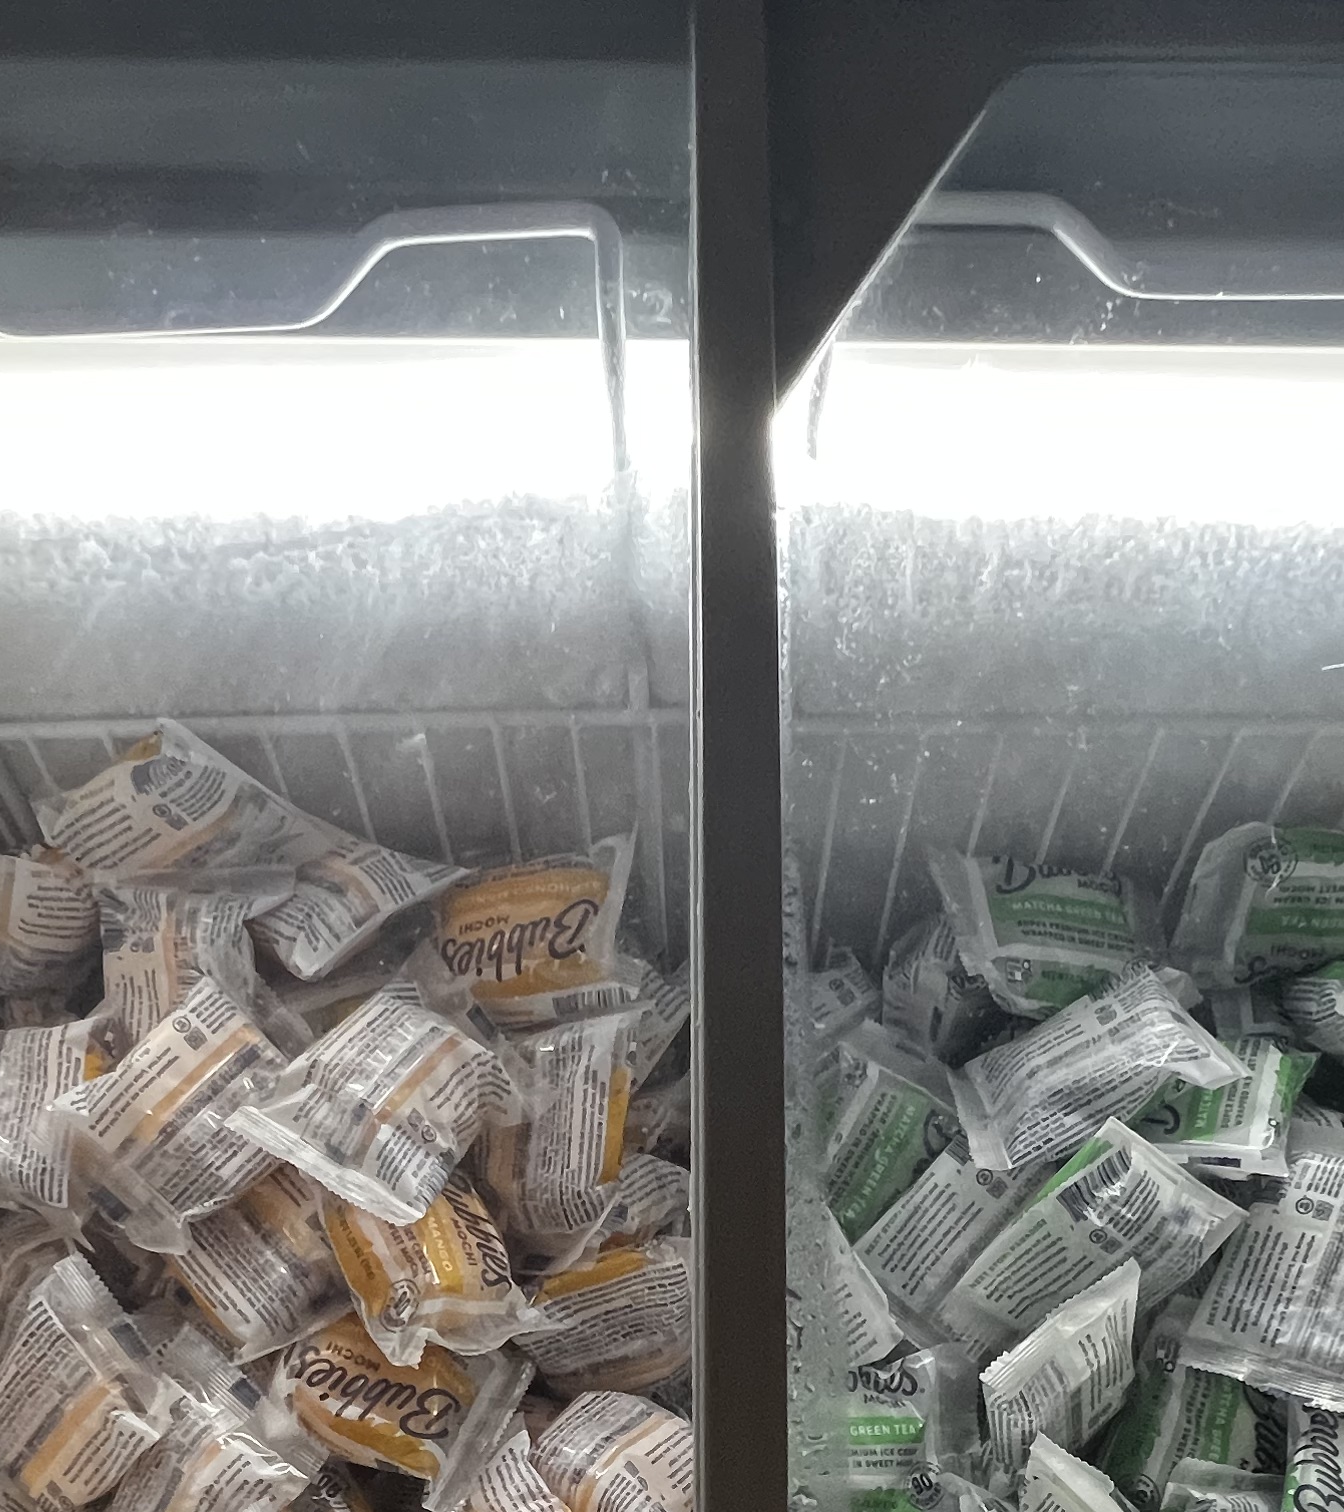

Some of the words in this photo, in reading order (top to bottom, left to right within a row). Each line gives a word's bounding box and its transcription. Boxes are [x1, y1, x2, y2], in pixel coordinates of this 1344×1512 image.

[459, 915, 511, 936] MOCHI
[1012, 900, 1062, 912] MATCHA
[441, 899, 599, 982] Bubbies
[427, 1216, 453, 1272] MANGO
[450, 1217, 477, 1266] MOCHI
[327, 1341, 380, 1372] MOCHI
[286, 1343, 460, 1439] Bubbies
[850, 1424, 890, 1437] GREEN
[894, 1424, 916, 1435] TEA
